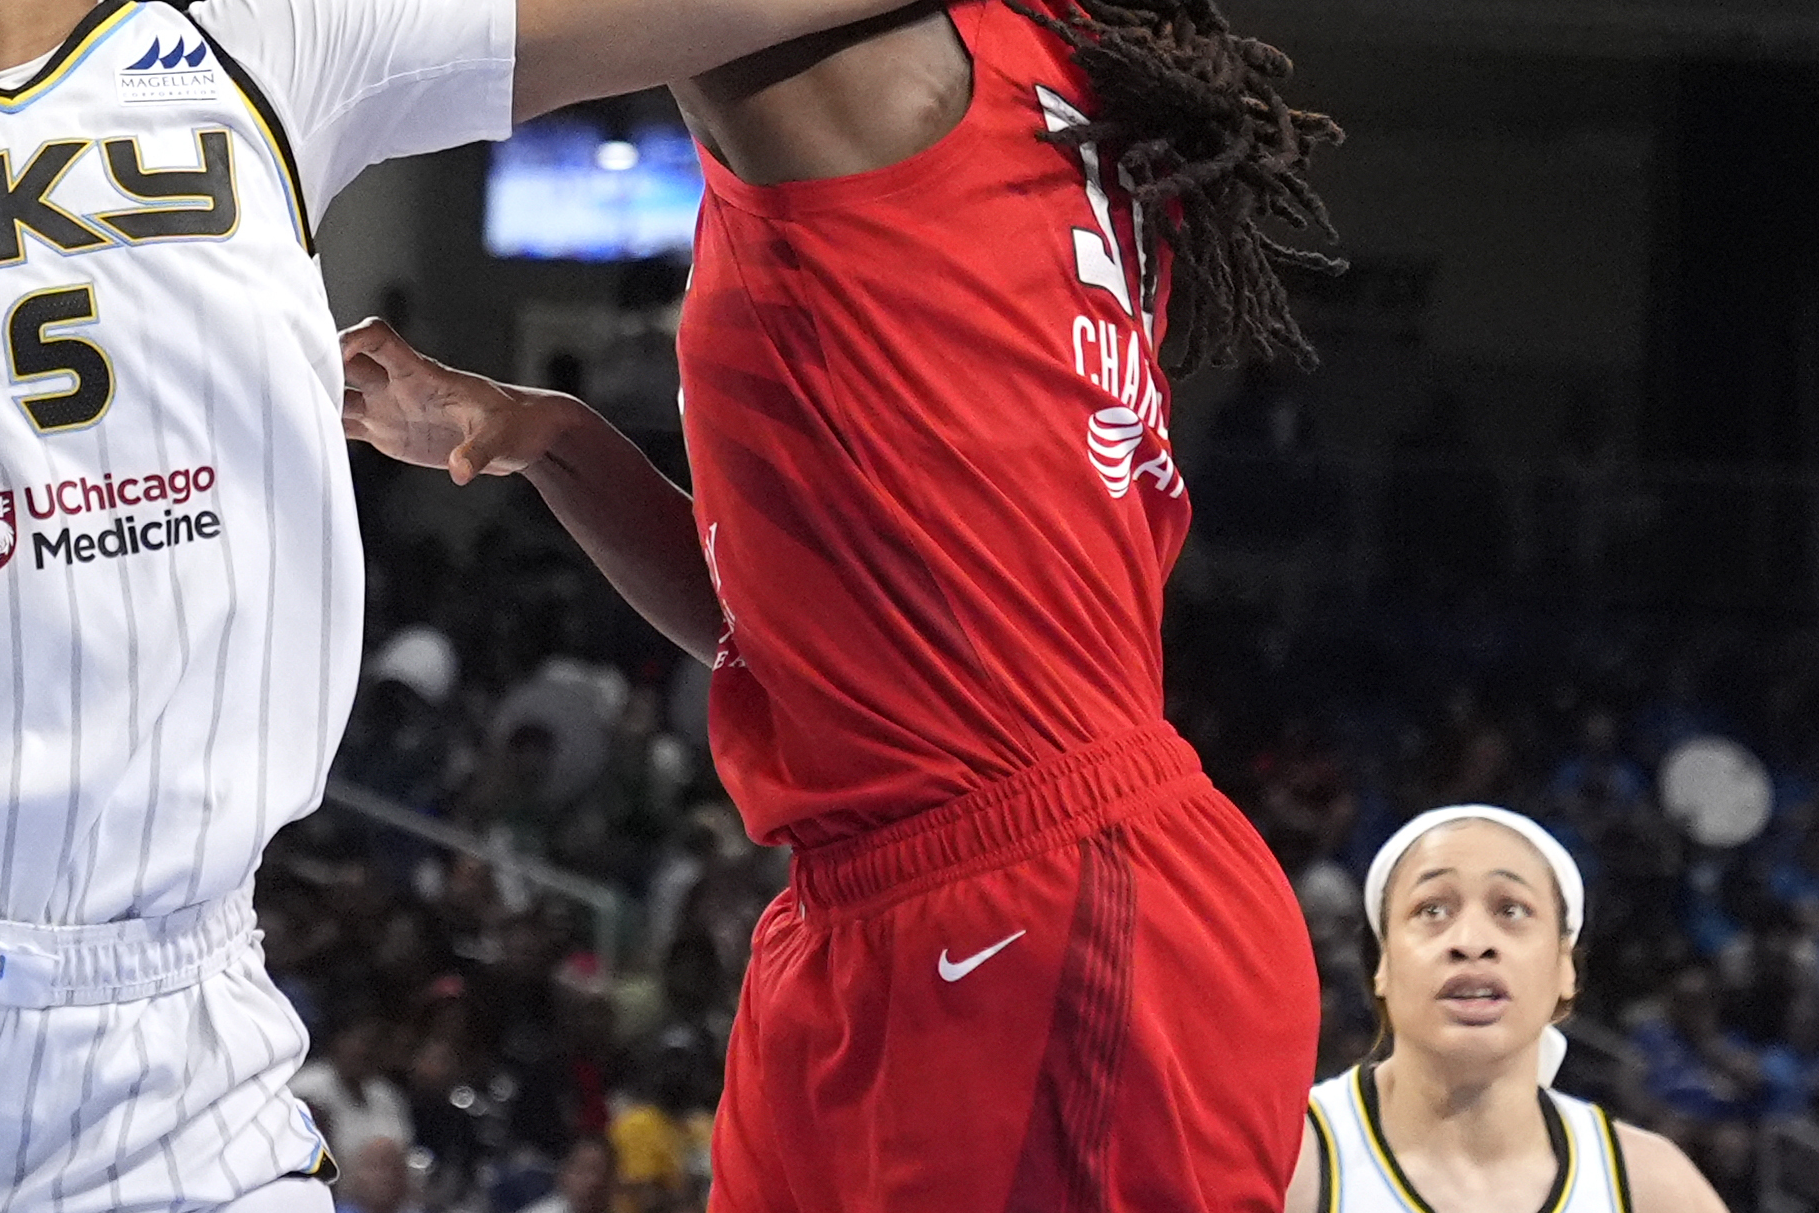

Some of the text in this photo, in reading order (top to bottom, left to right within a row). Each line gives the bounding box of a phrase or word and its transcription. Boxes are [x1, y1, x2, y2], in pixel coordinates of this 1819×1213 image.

[121, 73, 215, 87] MAGELLAN
[2, 282, 116, 436] 5
[25, 466, 215, 519] UChicago
[32, 509, 221, 570] Medicine
